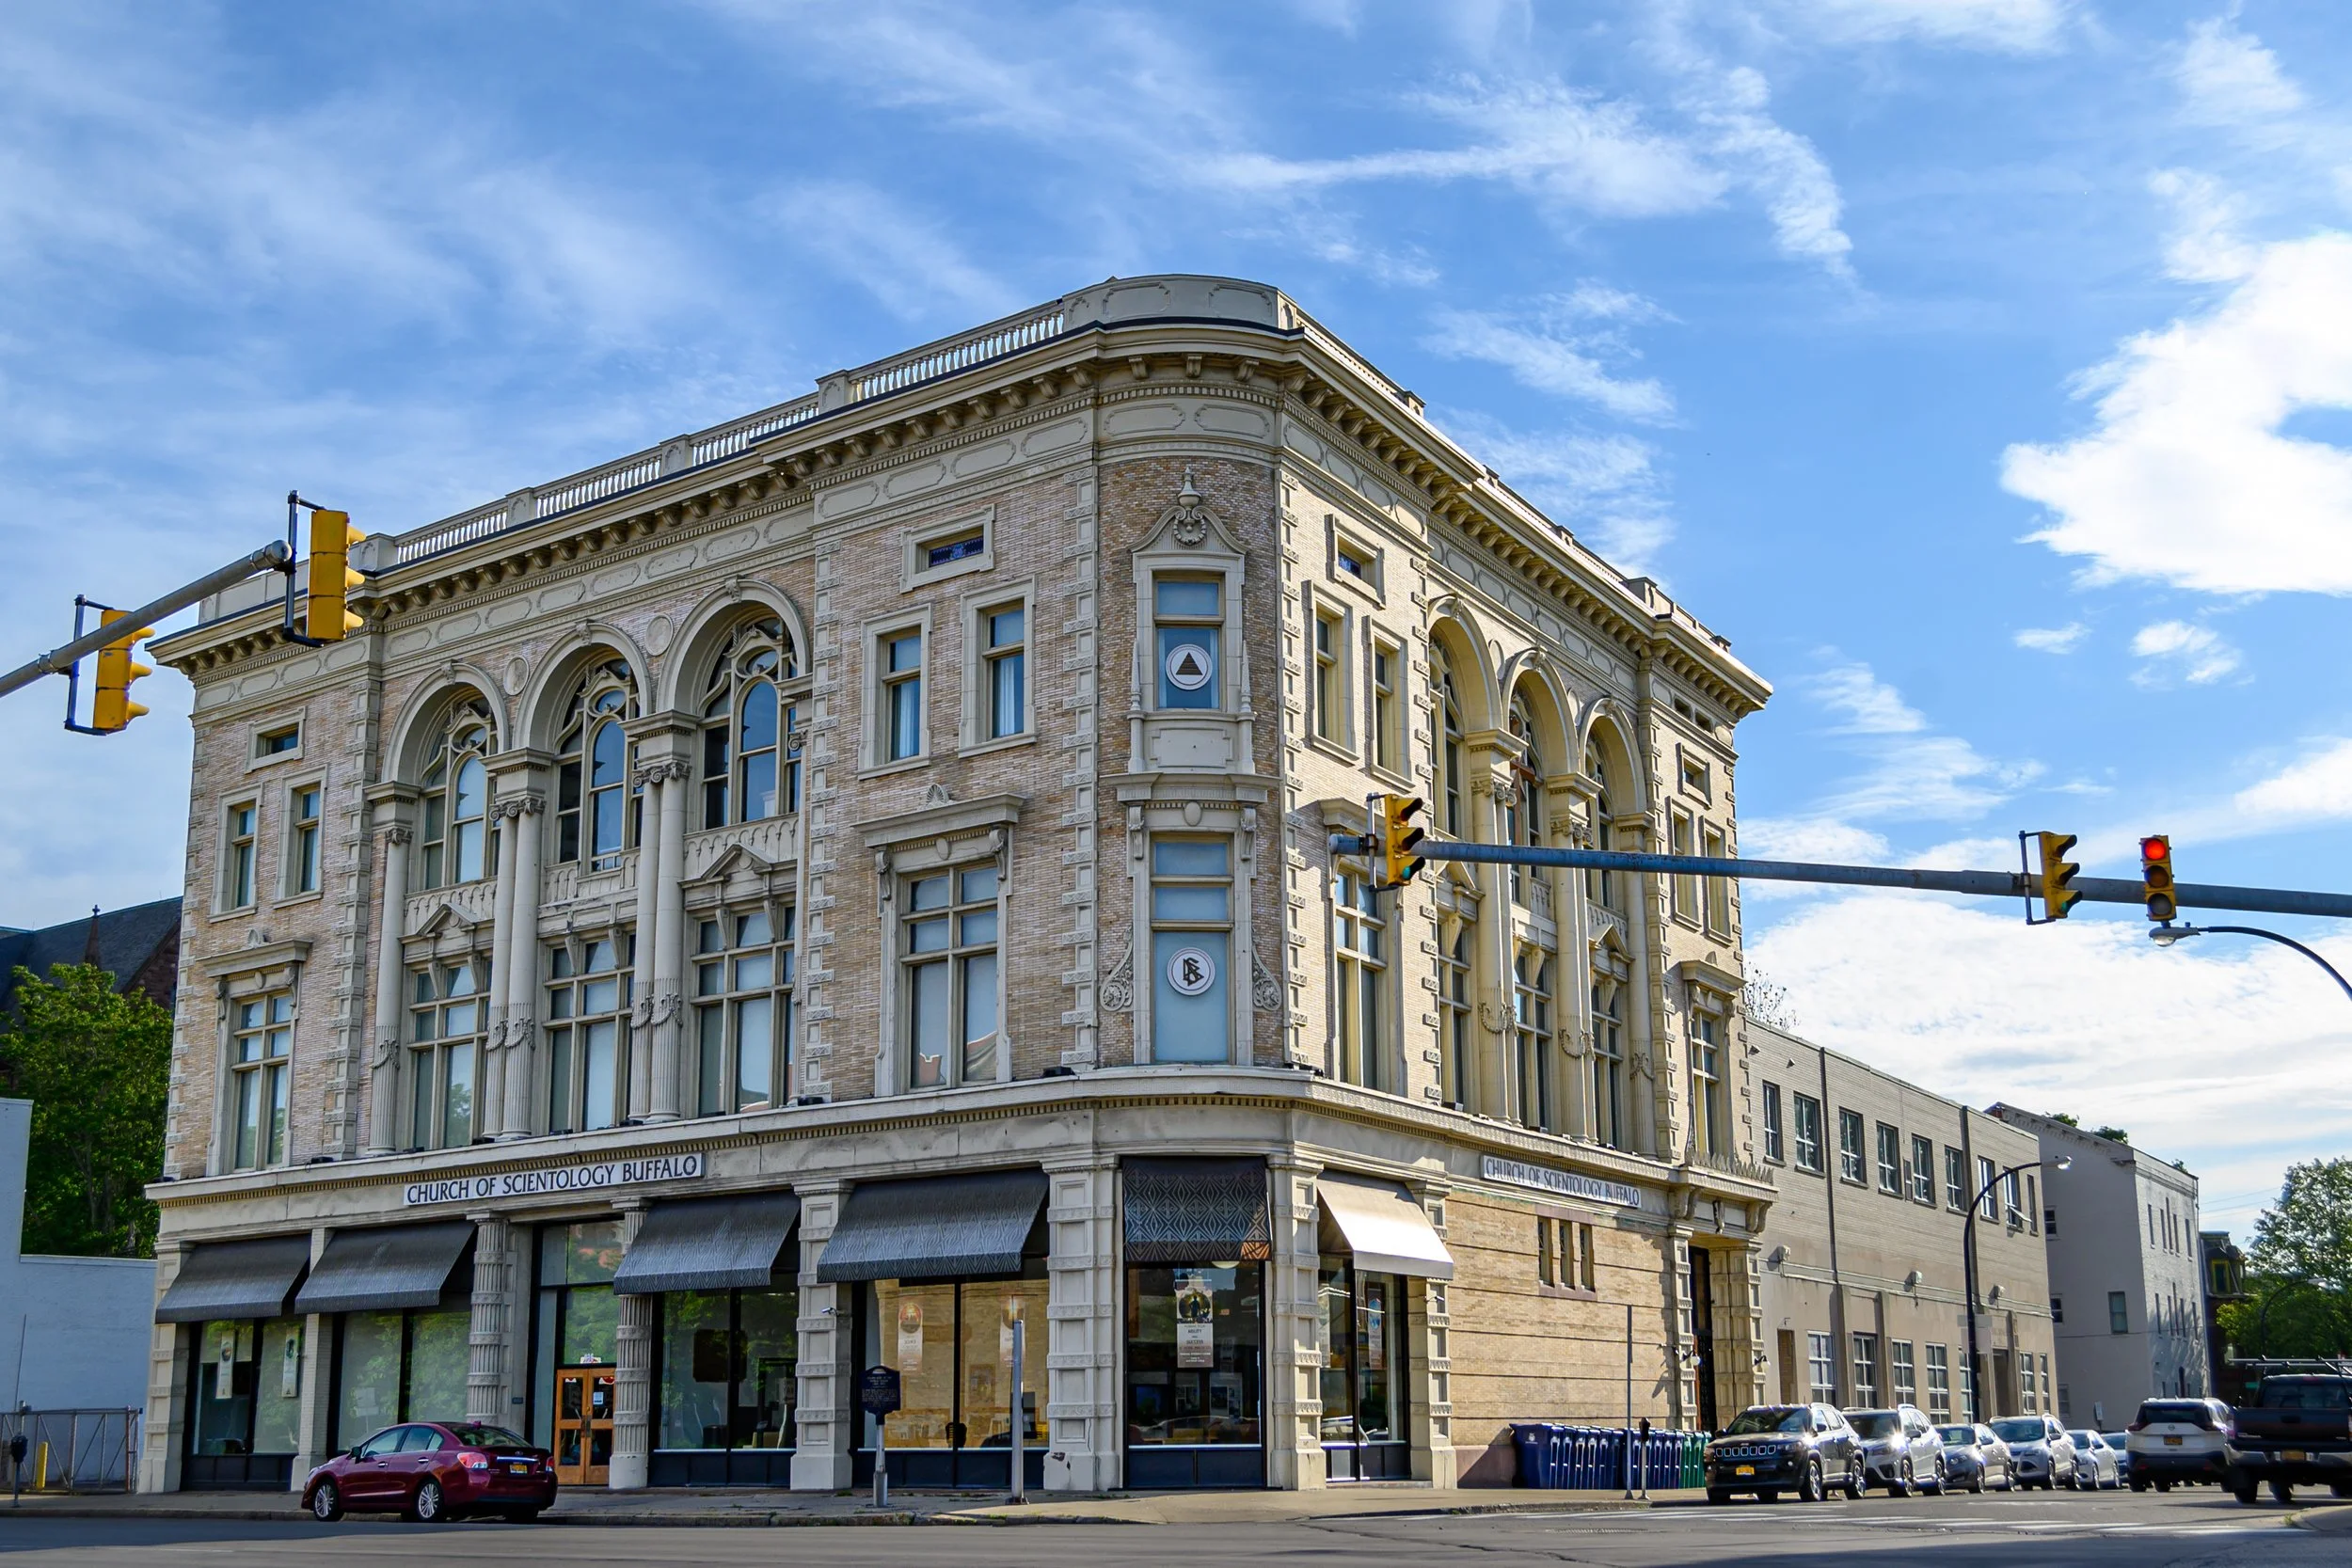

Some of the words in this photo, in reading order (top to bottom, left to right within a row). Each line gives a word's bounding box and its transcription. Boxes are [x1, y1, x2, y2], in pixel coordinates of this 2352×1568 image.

[407, 1180, 469, 1204] CHURCH
[476, 1178, 497, 1197] OF
[502, 1164, 615, 1195] SCIENTOLOGY
[622, 1155, 697, 1182] BUFFALO
[1486, 1158, 1525, 1184] CHURCH
[1529, 1166, 1540, 1186] OF
[1544, 1170, 1602, 1199] SCIENTOLOGY
[1605, 1182, 1640, 1205] BUFFALO
